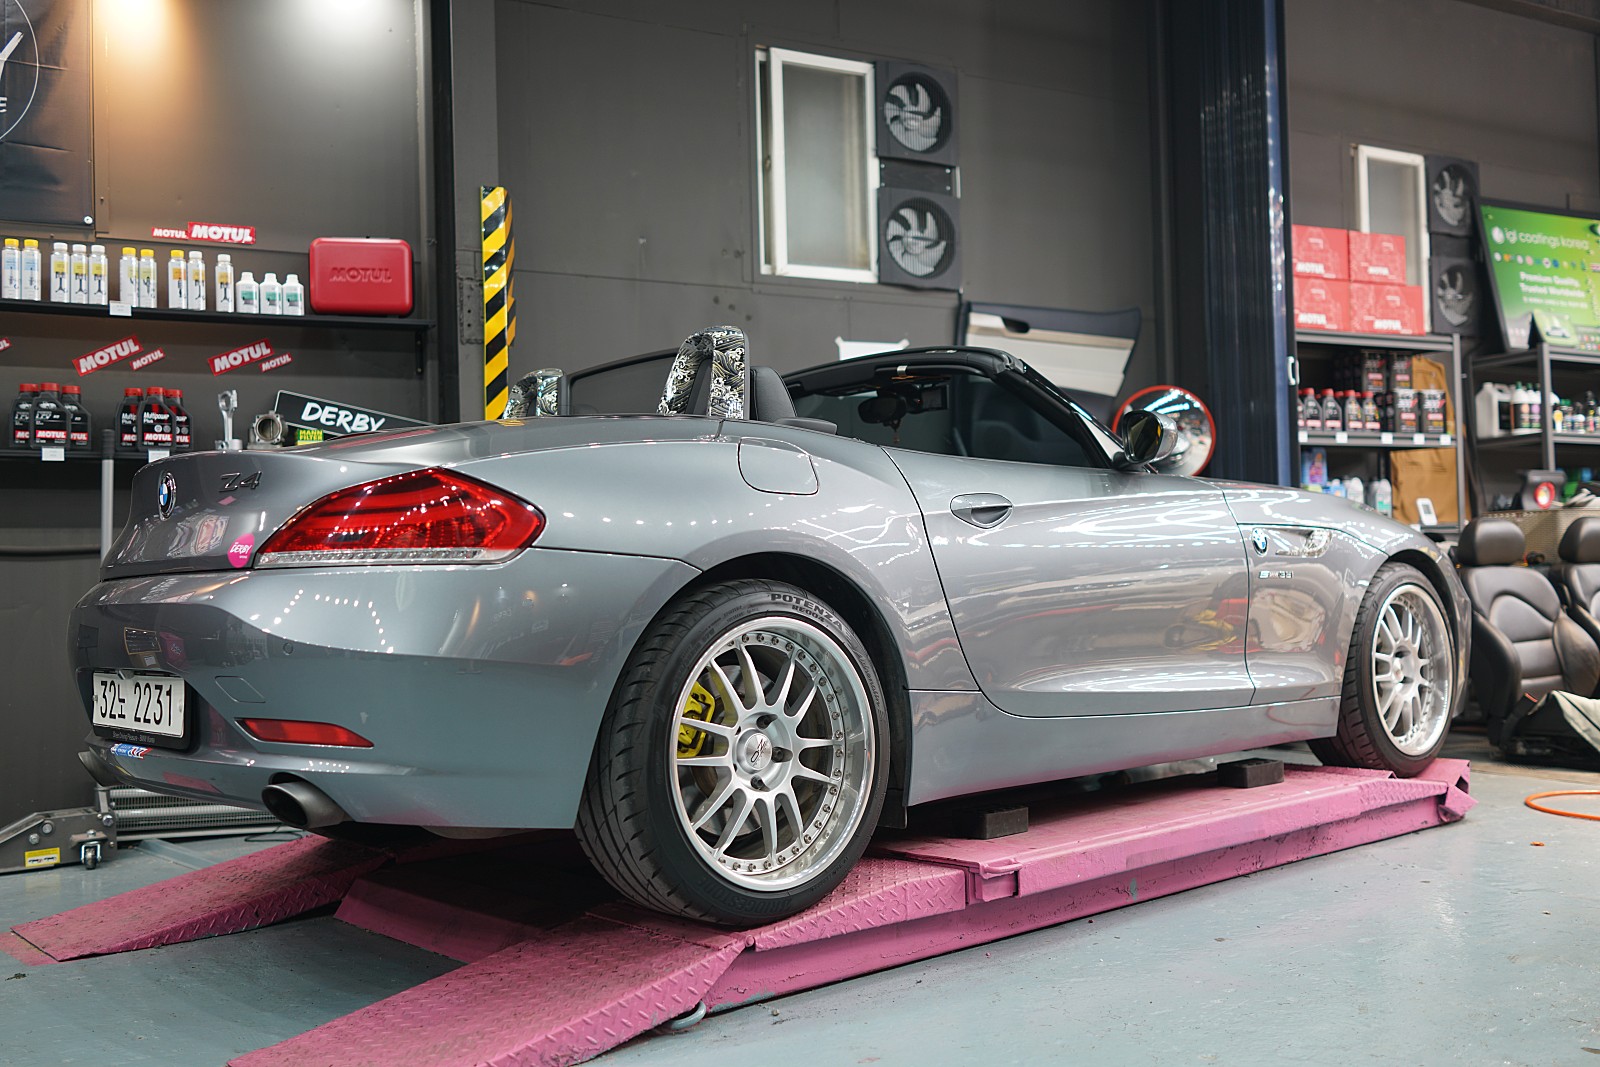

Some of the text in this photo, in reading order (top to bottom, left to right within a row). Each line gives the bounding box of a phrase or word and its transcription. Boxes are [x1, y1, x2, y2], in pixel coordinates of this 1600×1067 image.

[152, 228, 188, 239] MOTUL
[191, 224, 253, 243] MOTUL
[329, 267, 393, 283] MOTUL
[77, 338, 140, 374] MOTUL
[132, 349, 164, 371] MOTUL
[213, 342, 271, 373] MOTUL
[261, 353, 292, 372] MOTUL
[301, 401, 386, 433] DERBY
[37, 430, 66, 438] MOTUL
[145, 433, 172, 441] MOTUL
[218, 470, 262, 493] Z4
[770, 592, 845, 632] POTENZA
[100, 680, 173, 727] 32노 2231
